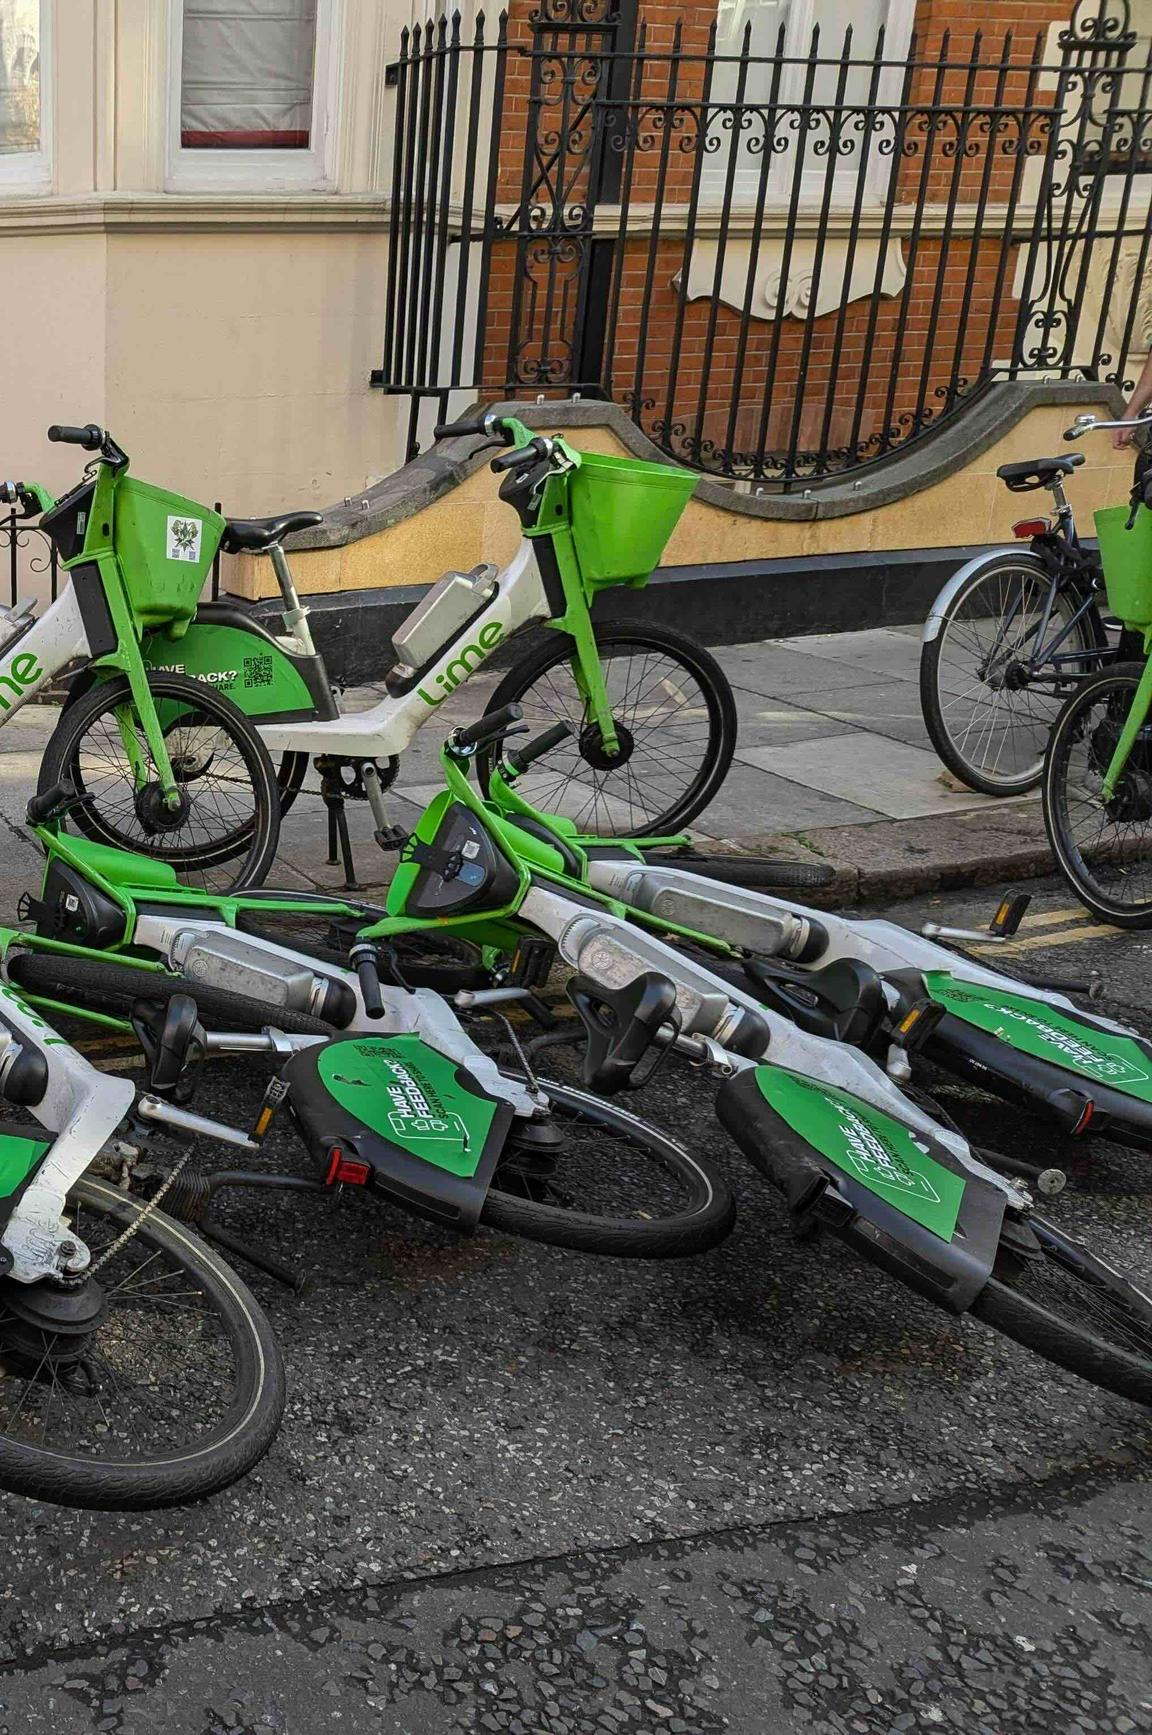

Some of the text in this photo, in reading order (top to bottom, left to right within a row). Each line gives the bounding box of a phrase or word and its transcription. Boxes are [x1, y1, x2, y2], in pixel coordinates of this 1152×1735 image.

[1038, 1033, 1094, 1064] HAVE
[383, 1059, 434, 1118] FEEDBACK?
[386, 1086, 415, 1118] HAVE
[838, 1124, 877, 1164] HAVE
